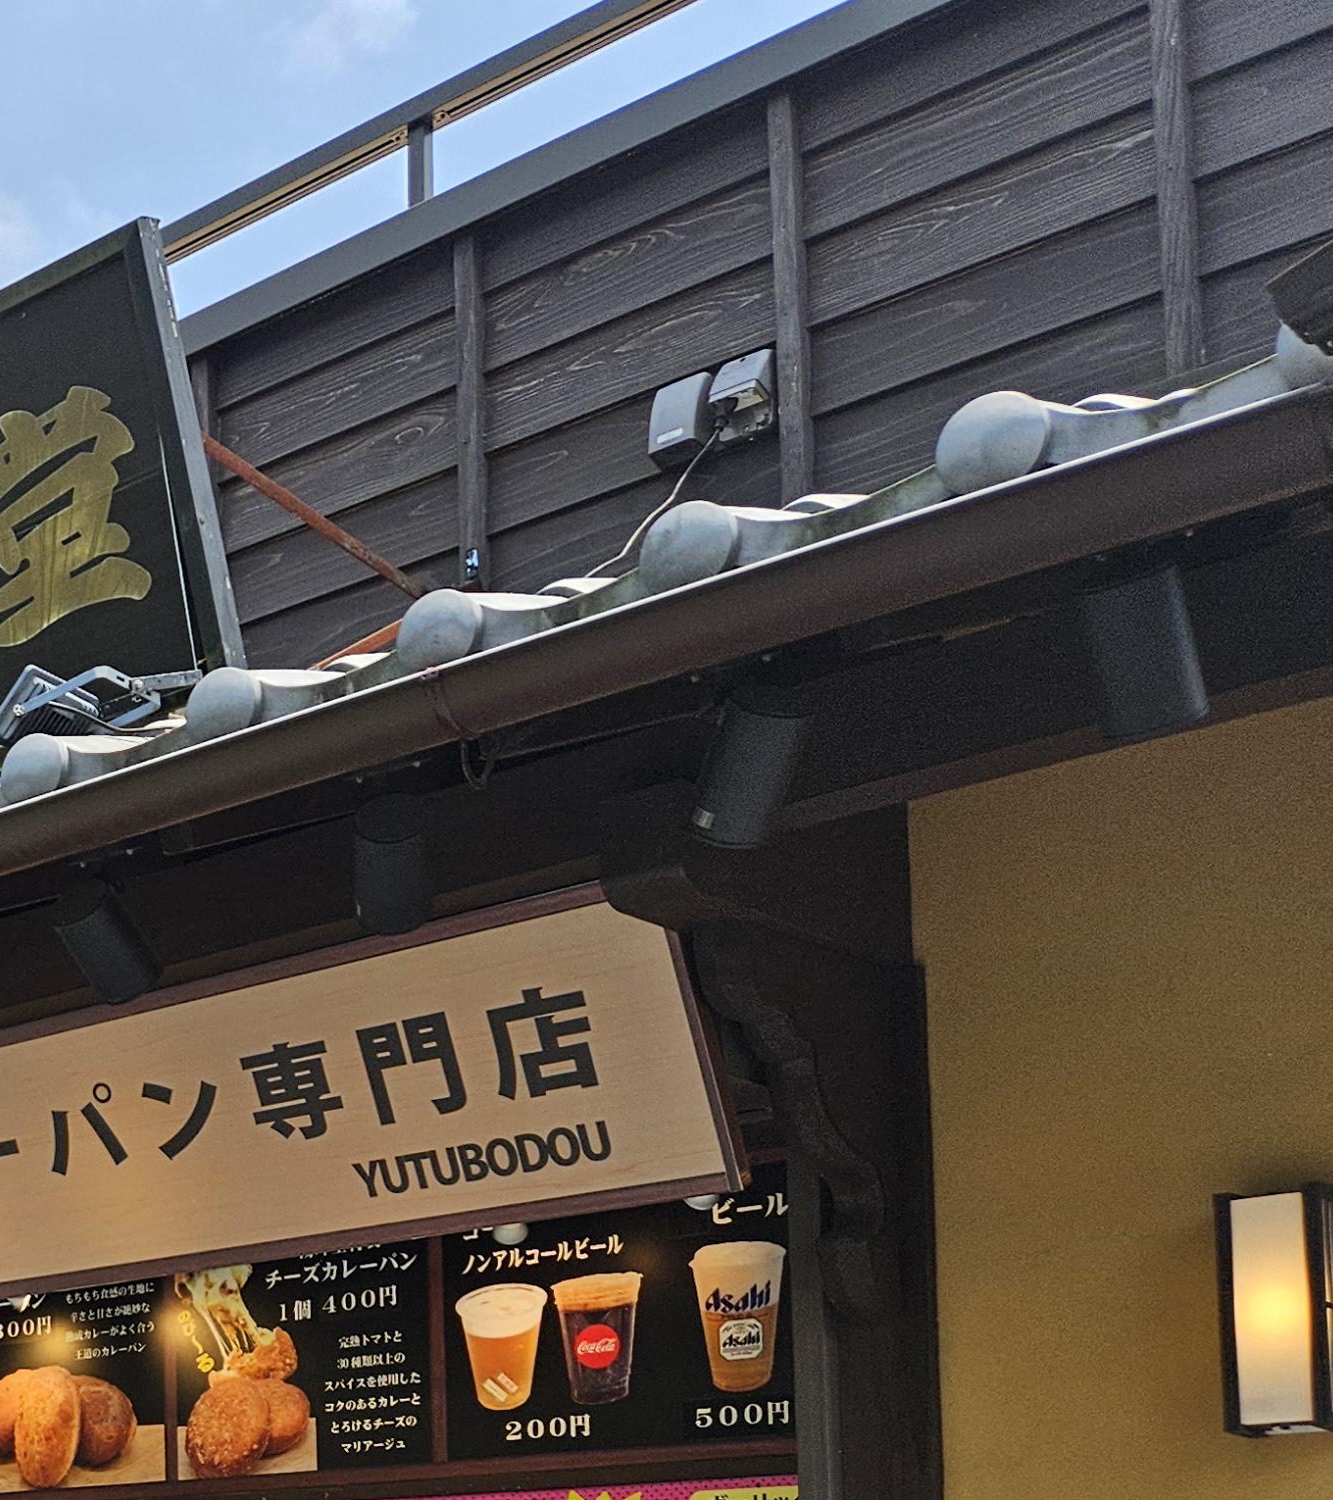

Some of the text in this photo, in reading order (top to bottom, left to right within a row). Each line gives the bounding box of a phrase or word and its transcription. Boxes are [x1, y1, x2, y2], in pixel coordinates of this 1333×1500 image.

[352, 1120, 613, 1199] YUTUBODOU
[711, 1192, 789, 1226] ビール
[461, 1233, 625, 1276] ノンアルコールビール
[264, 1251, 419, 1291] チーズカレーパン
[321, 1283, 398, 1315] 400円
[705, 1279, 771, 1314] Asahi
[74, 1341, 147, 1361] 王道のカレーパン
[338, 1330, 403, 1350] 完熟トマトと
[721, 1331, 761, 1348] Asahi
[323, 1371, 423, 1393] スパイスを使用した
[324, 1392, 422, 1414] コクのあるカレーと
[694, 1399, 790, 1429] 500円
[330, 1414, 418, 1435] とろけるチーズの
[505, 1412, 591, 1442] 200円
[340, 1437, 406, 1454] マリアージュ
